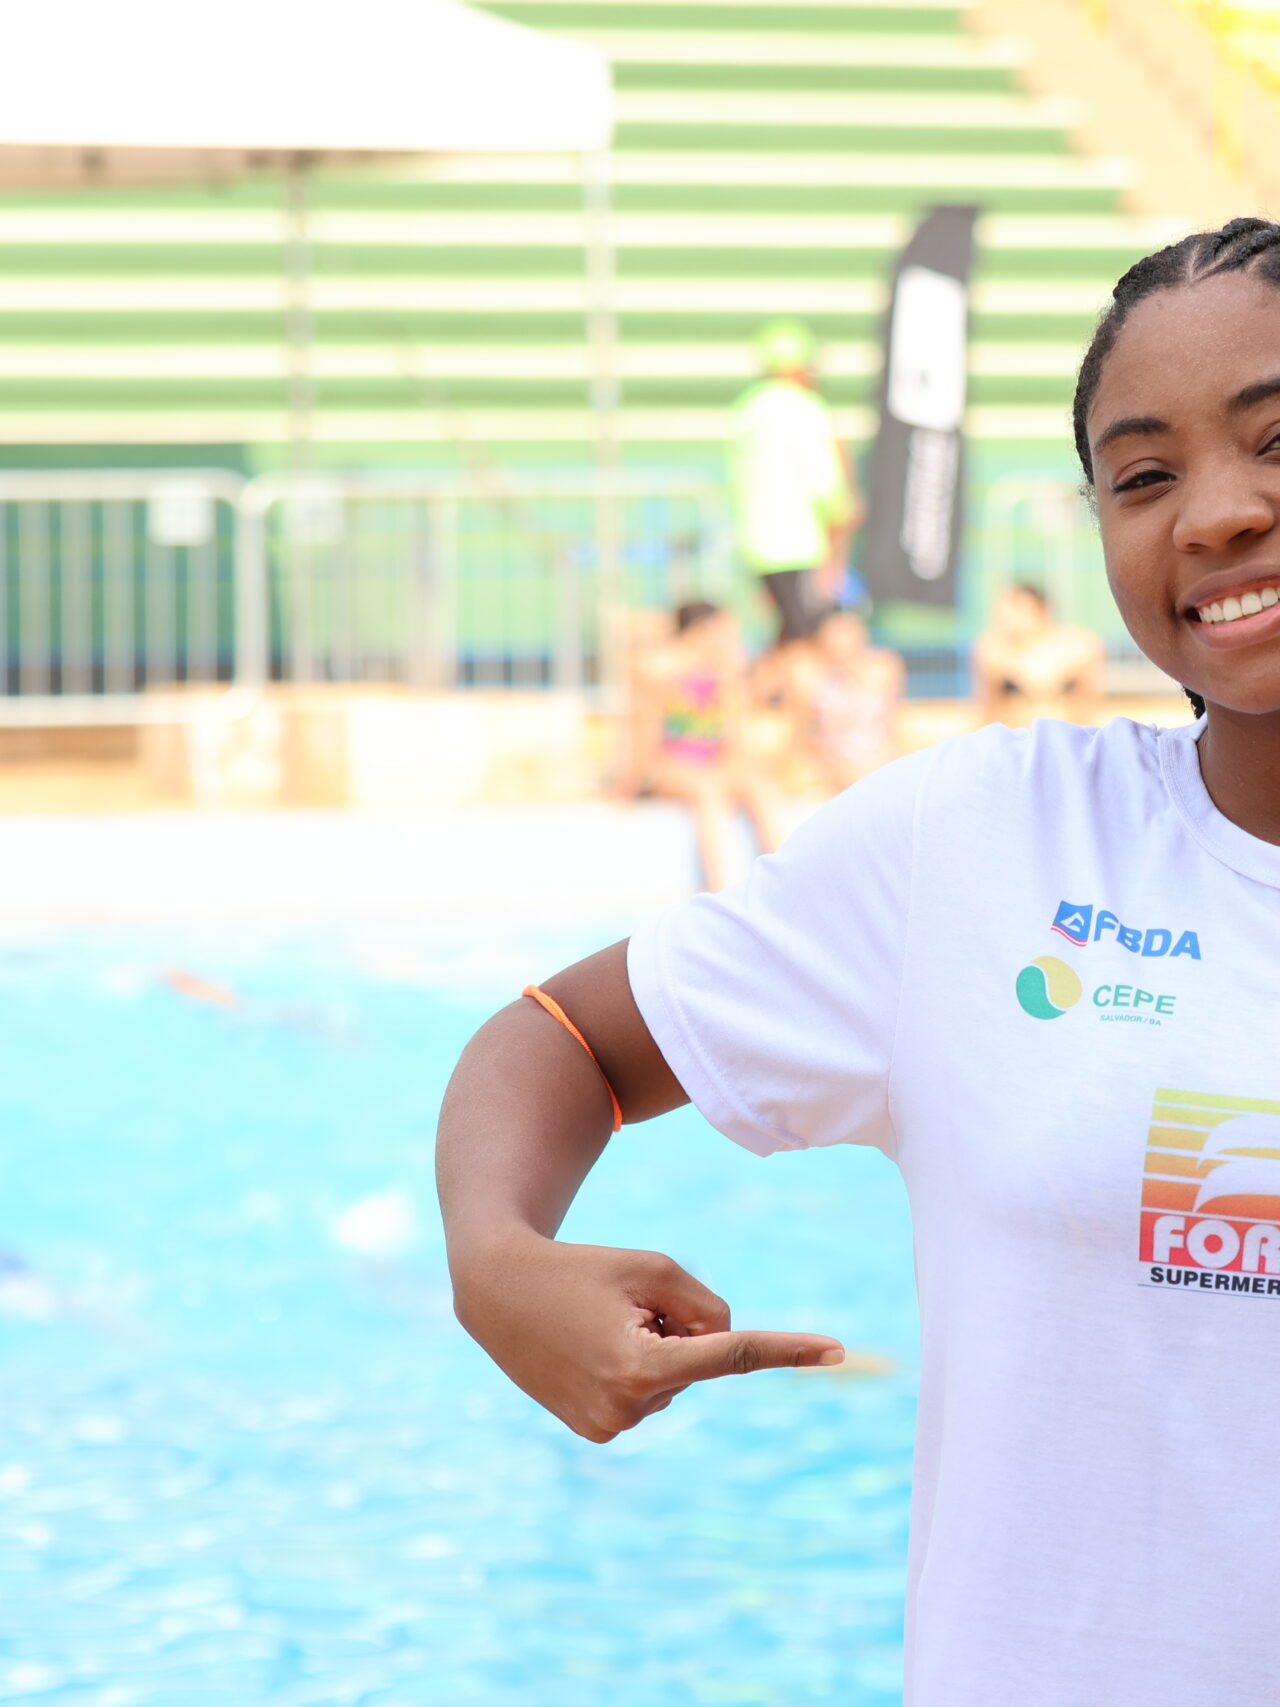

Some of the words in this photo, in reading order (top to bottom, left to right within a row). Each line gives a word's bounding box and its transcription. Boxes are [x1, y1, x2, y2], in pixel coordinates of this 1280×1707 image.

[1094, 910, 1201, 960] FBDA
[1092, 984, 1177, 1015] CEPE
[1100, 1014, 1142, 1024] SALVADOR
[1149, 1018, 1162, 1026] BA
